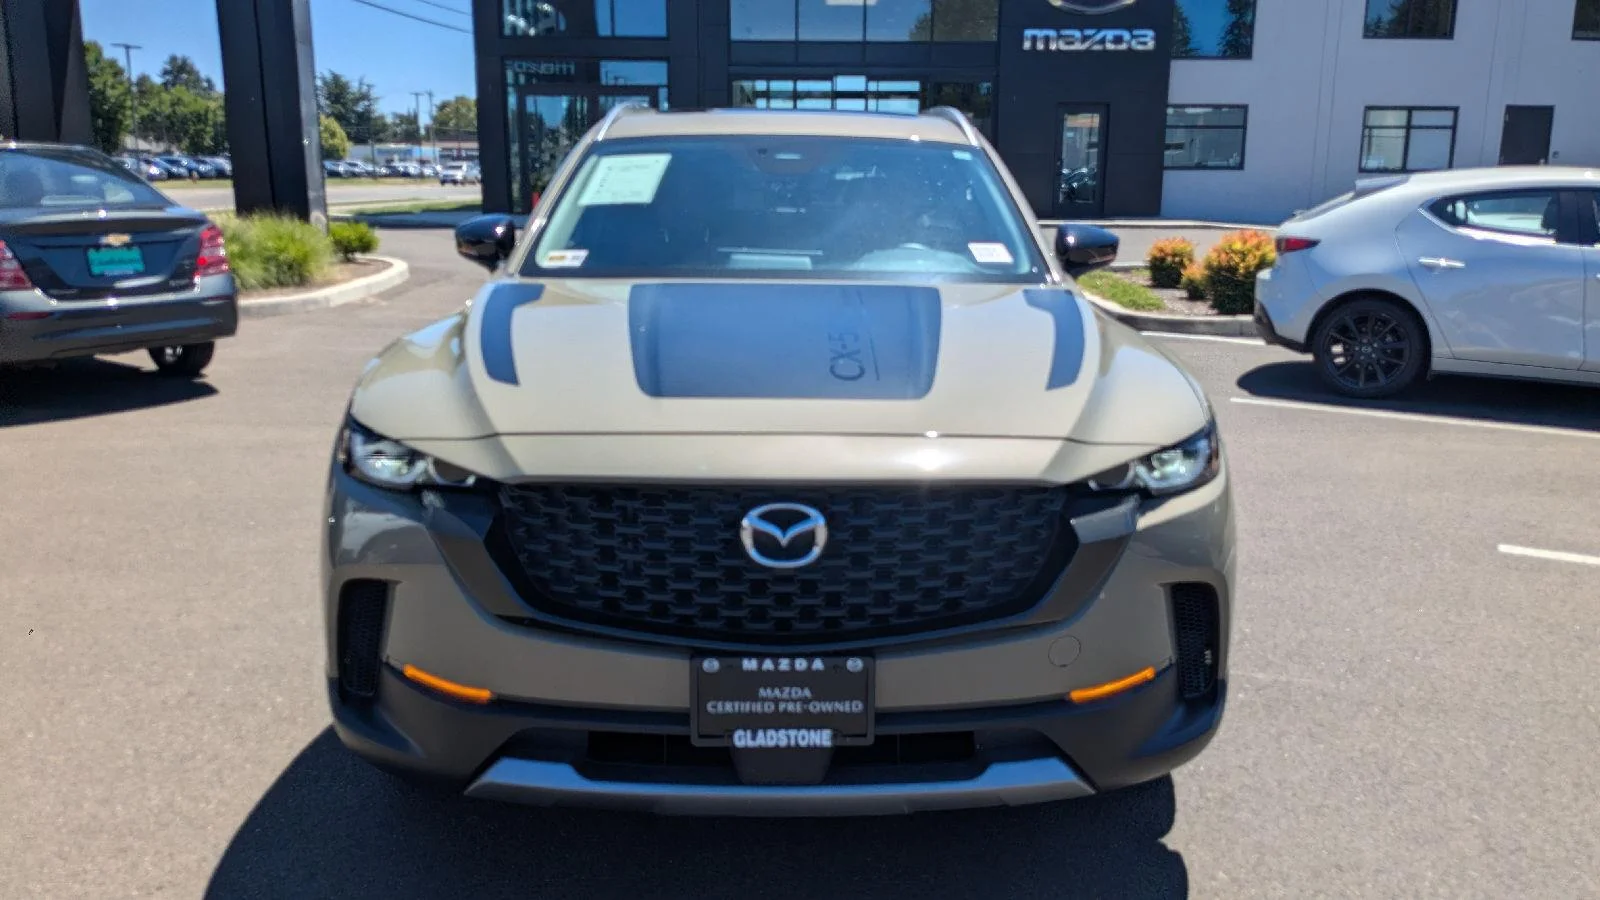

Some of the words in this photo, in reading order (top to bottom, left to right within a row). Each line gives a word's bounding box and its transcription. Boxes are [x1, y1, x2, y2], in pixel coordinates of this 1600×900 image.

[741, 657, 825, 672] MAZDA
[758, 686, 812, 699] MAZDA
[706, 700, 775, 714] CERTIFIED
[778, 700, 864, 713] PRE-OWNED
[732, 728, 833, 748] GLADSTONE
